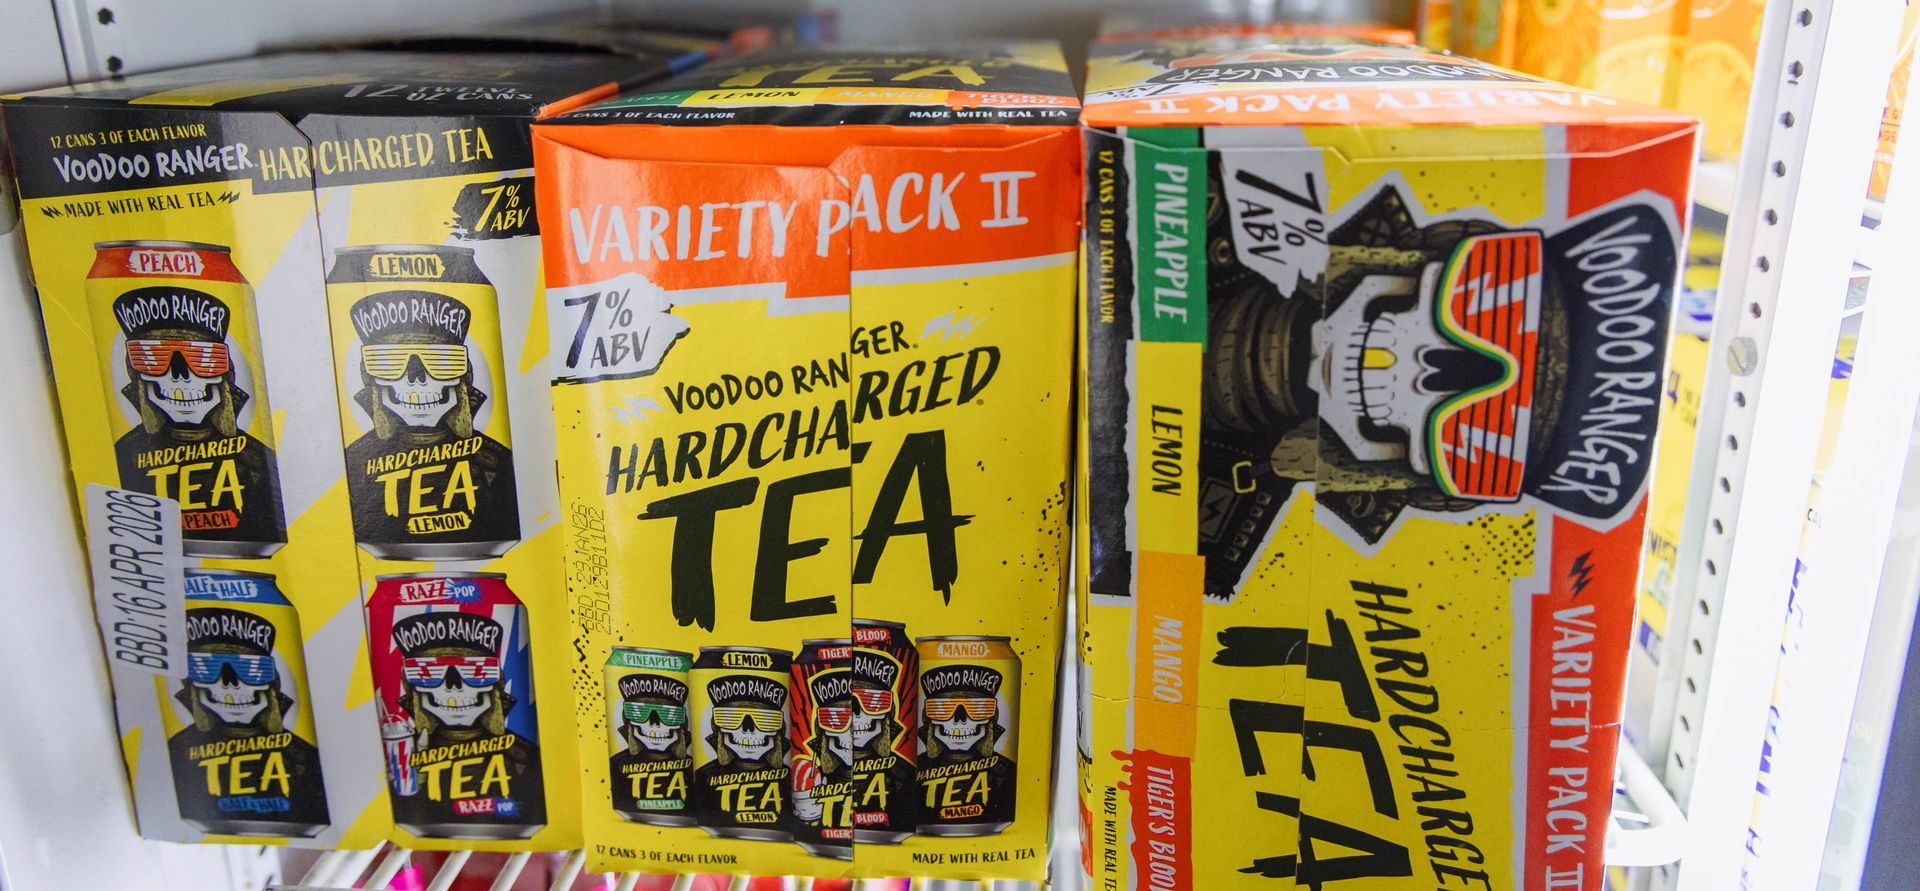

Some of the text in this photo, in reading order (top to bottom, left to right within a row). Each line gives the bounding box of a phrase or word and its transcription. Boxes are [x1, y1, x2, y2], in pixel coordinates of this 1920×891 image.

[1166, 66, 1339, 82] RANGER
[344, 84, 408, 98] 12
[456, 92, 533, 101] CANS
[708, 91, 801, 101] LEMON
[1206, 93, 1350, 113] PACK
[1375, 90, 1616, 111] VARIETY
[909, 111, 951, 119] MADE
[50, 123, 208, 149] 12 CANS 3 OF EACH FLAVOR
[53, 152, 150, 183] VOODOO
[441, 127, 494, 164] TEA
[1099, 150, 1114, 164] 12
[1099, 168, 1114, 203] CANS
[64, 191, 216, 218] MADE WITH REAL TEA
[474, 184, 520, 232] 7%
[490, 206, 531, 232] ABV
[569, 170, 1037, 265] VARIETY PACK II
[1235, 169, 1329, 247] 7%
[1099, 218, 1115, 235] OF
[1237, 198, 1287, 265] ABV
[1099, 240, 1115, 273] EACH
[1154, 162, 1189, 324] PINEAPPLE
[139, 252, 197, 273] PEACH
[378, 256, 438, 276] LEMON
[117, 294, 225, 337] VOODOO RANGER
[1099, 278, 1115, 324] FLAVOR
[354, 297, 466, 338] VOODOO RANGER
[564, 287, 634, 369] 7%
[590, 325, 651, 369] ABV
[1539, 216, 1660, 505] VOODOO RANGER
[663, 368, 785, 416] VOODOO
[605, 345, 1001, 496] HARDCHARGED
[138, 435, 247, 469] HARDCHARGED
[366, 436, 483, 475] HARDCHARGED
[1151, 403, 1184, 496] LEMON
[146, 459, 245, 514] TEA
[375, 460, 479, 518] TEA
[184, 512, 232, 529] PEACH
[413, 514, 466, 533] LEMON
[637, 429, 977, 634] TEA
[105, 490, 169, 670] BBD:16 APR 2026
[220, 581, 253, 597] HALF
[405, 582, 476, 600] RAZZ POP
[578, 594, 595, 632] BBD
[187, 615, 272, 651] ODOO RANGER
[395, 618, 499, 652] VOODOO RANGER
[821, 630, 887, 659] TIGER' BLOOD
[626, 653, 681, 669] PINEAPPLE
[727, 653, 768, 668] LEMON
[942, 643, 986, 656] MANGO
[1152, 614, 1183, 703] MANGO
[855, 656, 895, 688] RANGER
[924, 669, 999, 696] VOODOO RANGER
[1549, 605, 1598, 751] VARIETY
[620, 678, 686, 703] VOODOO RANGER
[709, 679, 784, 707] VOODOO RANGER
[189, 732, 292, 760] HARDCHARGED
[411, 734, 516, 767] HARDCHARGED
[1211, 608, 1414, 891] TEA
[1350, 580, 1493, 891] HARDCHARGE
[198, 751, 291, 797] TEA
[419, 754, 512, 802] TEA
[622, 758, 692, 774] HARDCHARGED
[710, 768, 789, 786] HARDCHARGED
[917, 756, 998, 781] HARDCHARGED
[627, 771, 688, 800] TEA
[716, 782, 784, 813] TEA
[922, 771, 991, 808] TEA
[1104, 785, 1117, 816] MADE
[458, 799, 513, 813] RAZZ POP
[640, 799, 683, 809] PINEAPPLE
[740, 812, 774, 823] LEMON
[856, 813, 885, 823] BLOOD
[944, 806, 981, 818] MANGO
[1545, 767, 1589, 856] PACK
[1104, 819, 1117, 846] WITH
[1147, 765, 1177, 891] TIGER'S BLOO
[596, 844, 738, 865] 12 CANS 3 OF EACH FLAVOR
[912, 848, 1036, 865] MADE WITH REAL TEA
[1104, 848, 1117, 878] REAL
